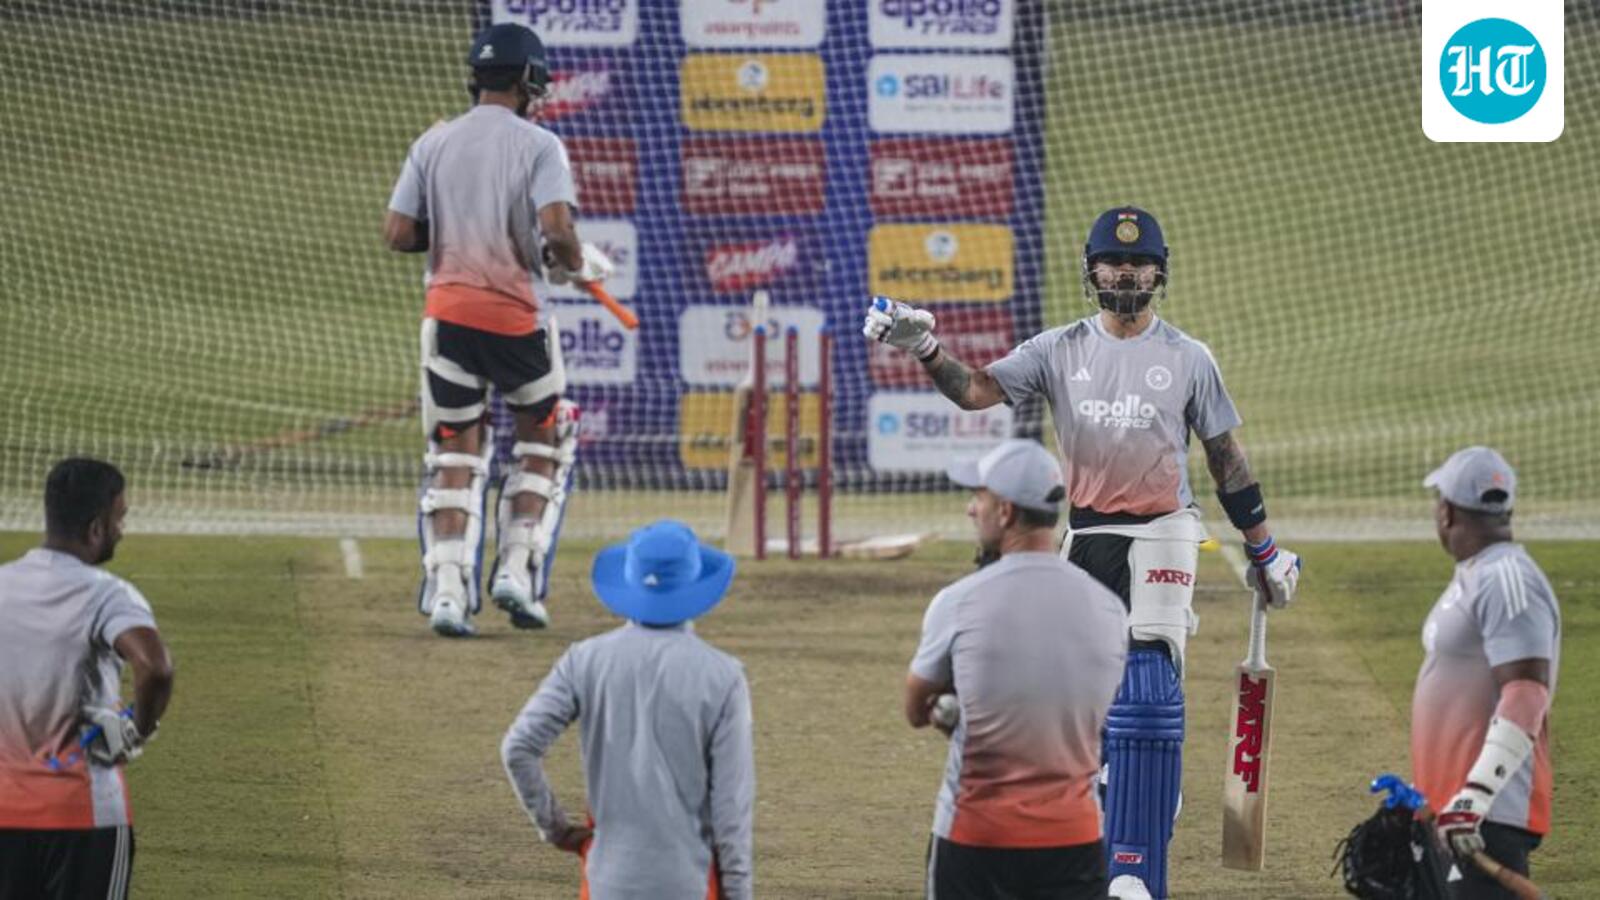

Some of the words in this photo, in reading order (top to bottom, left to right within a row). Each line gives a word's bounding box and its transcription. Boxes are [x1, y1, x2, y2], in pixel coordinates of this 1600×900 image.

[880, 0, 1000, 28] apollo
[953, 74, 1005, 98] Life
[559, 318, 624, 352] ollo
[1080, 395, 1156, 423] apollo
[1104, 417, 1153, 429] TYRES
[1233, 672, 1268, 793] MRF
